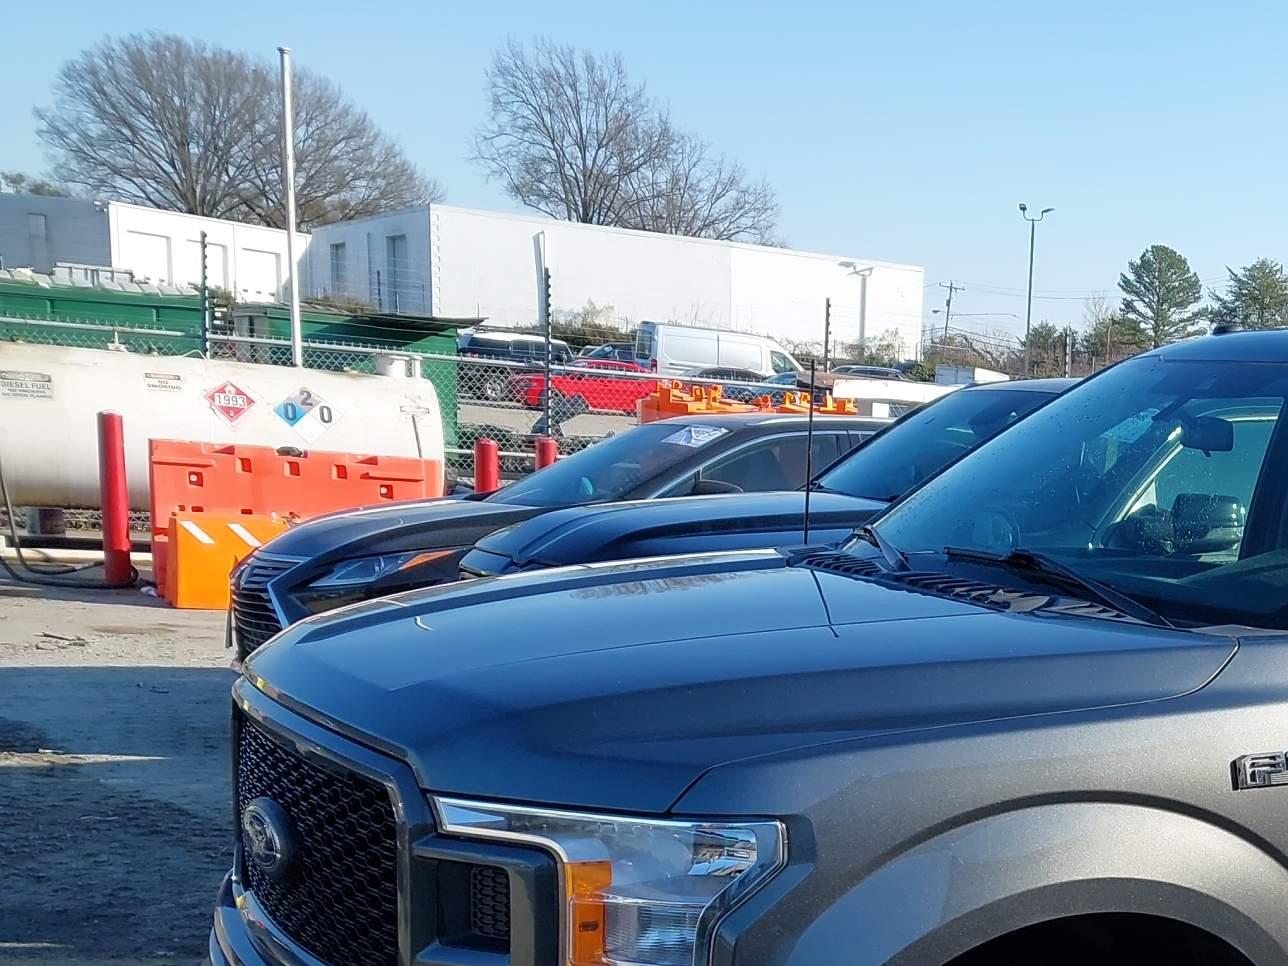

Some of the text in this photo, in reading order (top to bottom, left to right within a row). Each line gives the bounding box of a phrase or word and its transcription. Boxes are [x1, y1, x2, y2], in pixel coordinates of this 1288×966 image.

[0, 380, 51, 390] DIESEL FUEL
[216, 394, 246, 407] 1993
[299, 390, 313, 406] 2
[283, 402, 297, 421] 0
[319, 405, 333, 424] 0
